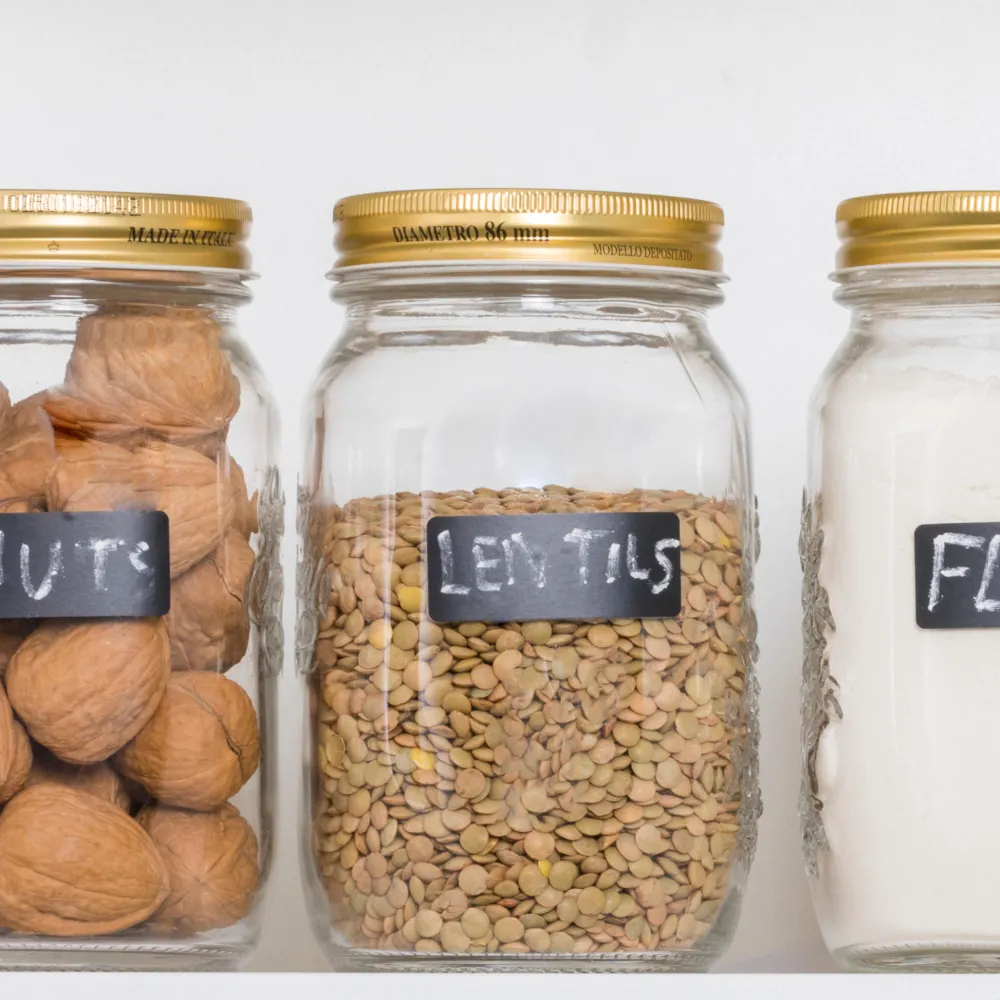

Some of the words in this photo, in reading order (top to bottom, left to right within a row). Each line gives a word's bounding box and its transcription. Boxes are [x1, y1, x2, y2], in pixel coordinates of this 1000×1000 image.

[127, 226, 180, 244] MADE
[182, 229, 201, 245] IN
[392, 225, 479, 243] DIAMETRO
[484, 221, 507, 241] 86
[512, 226, 550, 242] mm
[592, 243, 642, 258] MODELLO
[644, 246, 693, 262] DEPOSITATO
[437, 527, 681, 595] LENTILS
